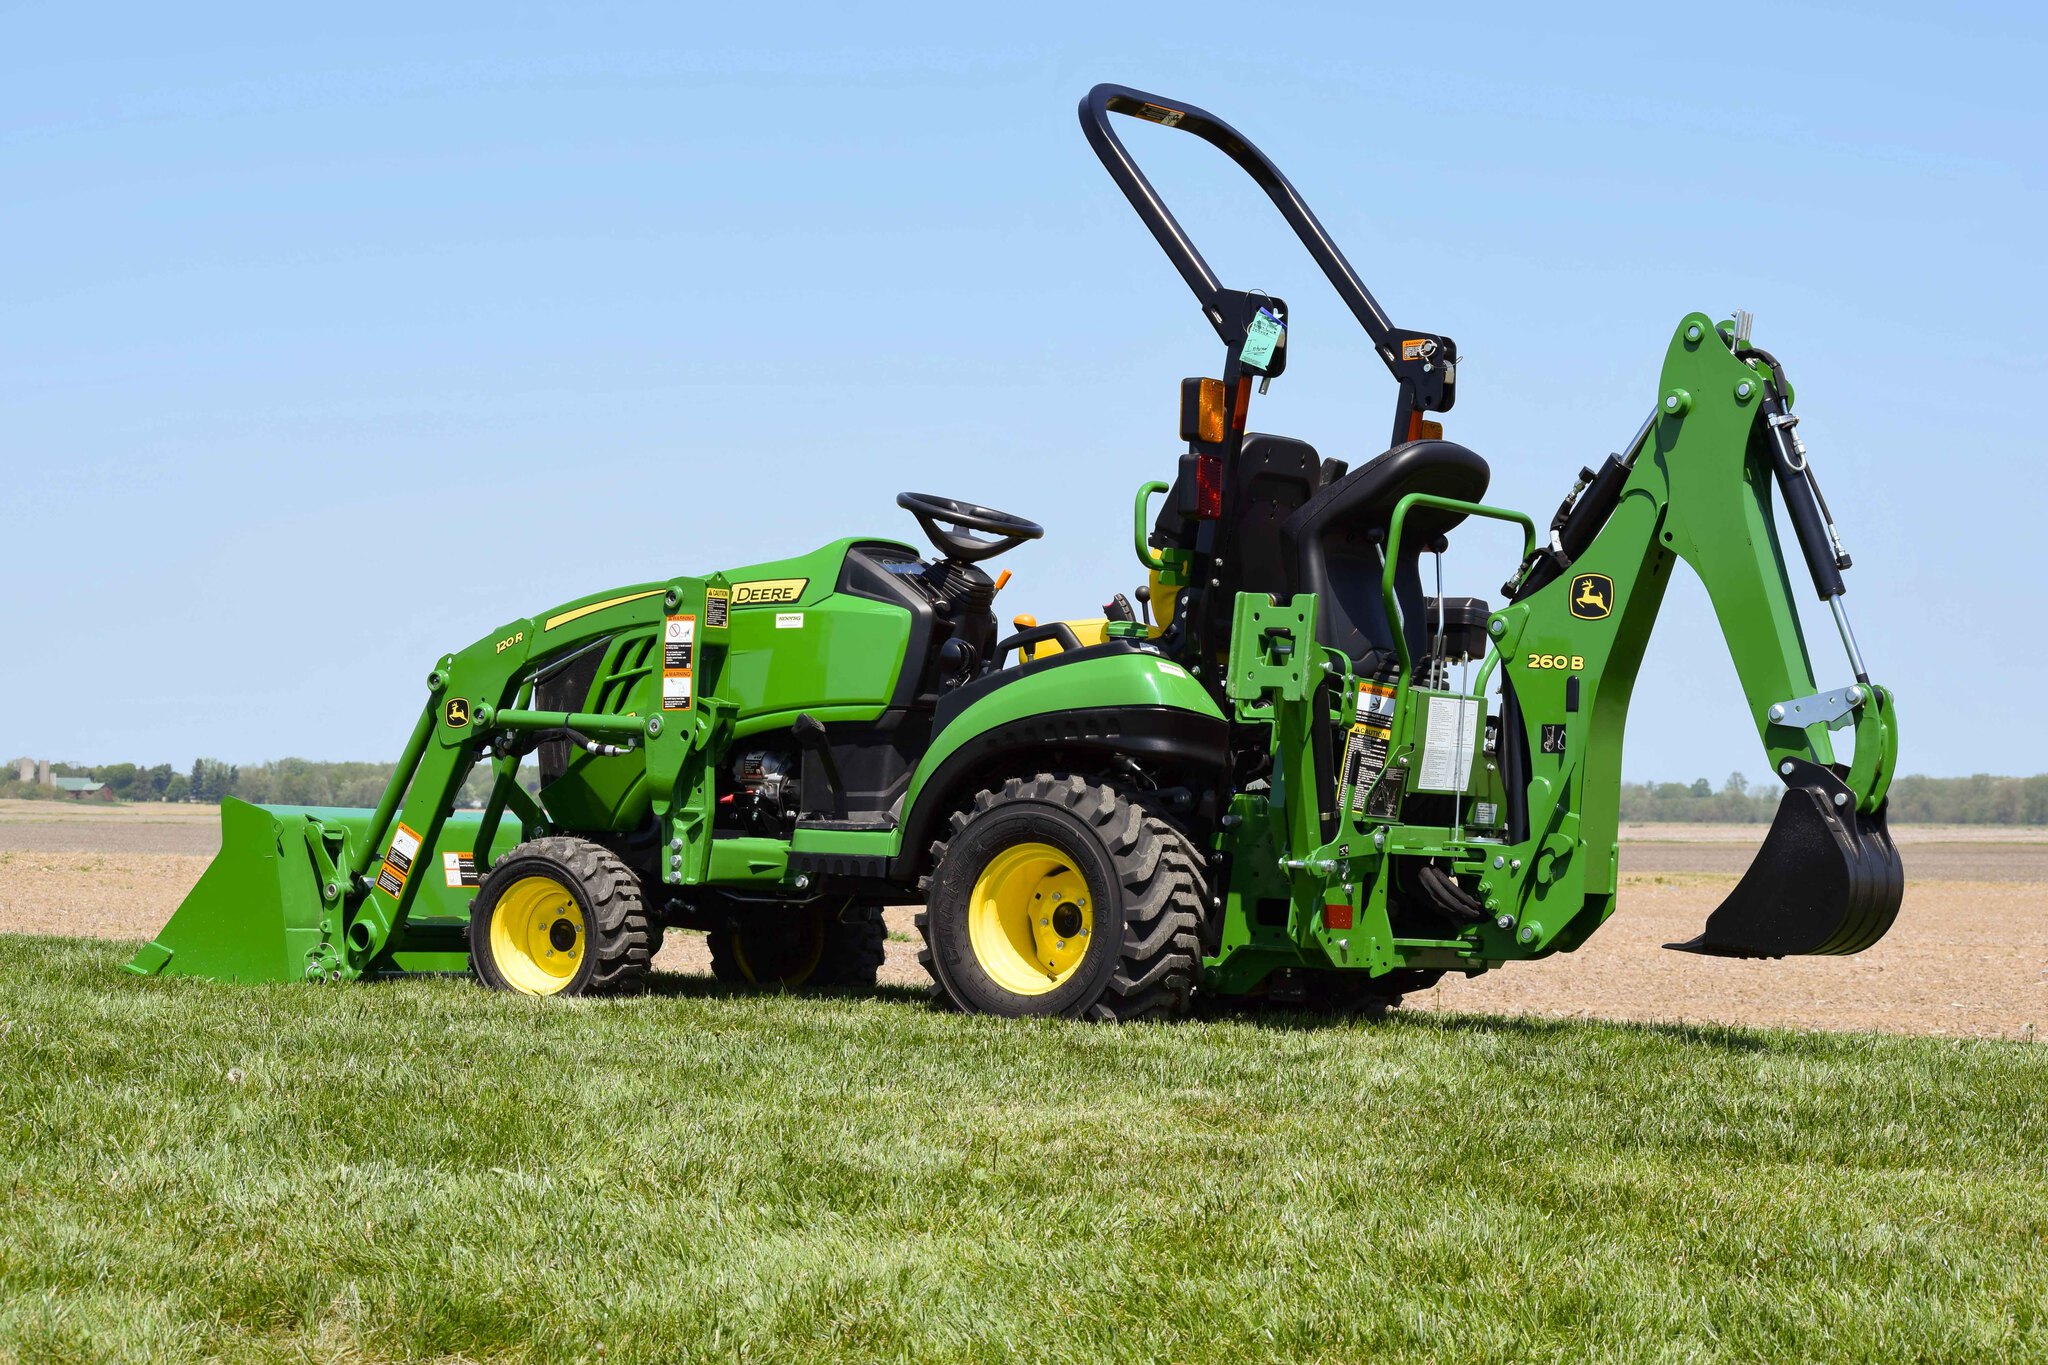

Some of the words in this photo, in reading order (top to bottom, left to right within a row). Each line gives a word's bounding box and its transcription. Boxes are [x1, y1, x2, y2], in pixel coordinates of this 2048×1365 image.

[713, 589, 728, 597] CAUTION
[737, 588, 794, 601] DEERE
[496, 637, 514, 654] 120
[515, 632, 523, 643] R
[1528, 654, 1568, 669] 260
[1570, 655, 1584, 671] B
[1367, 687, 1395, 698] WARNING
[1360, 727, 1387, 739] CAUTION
